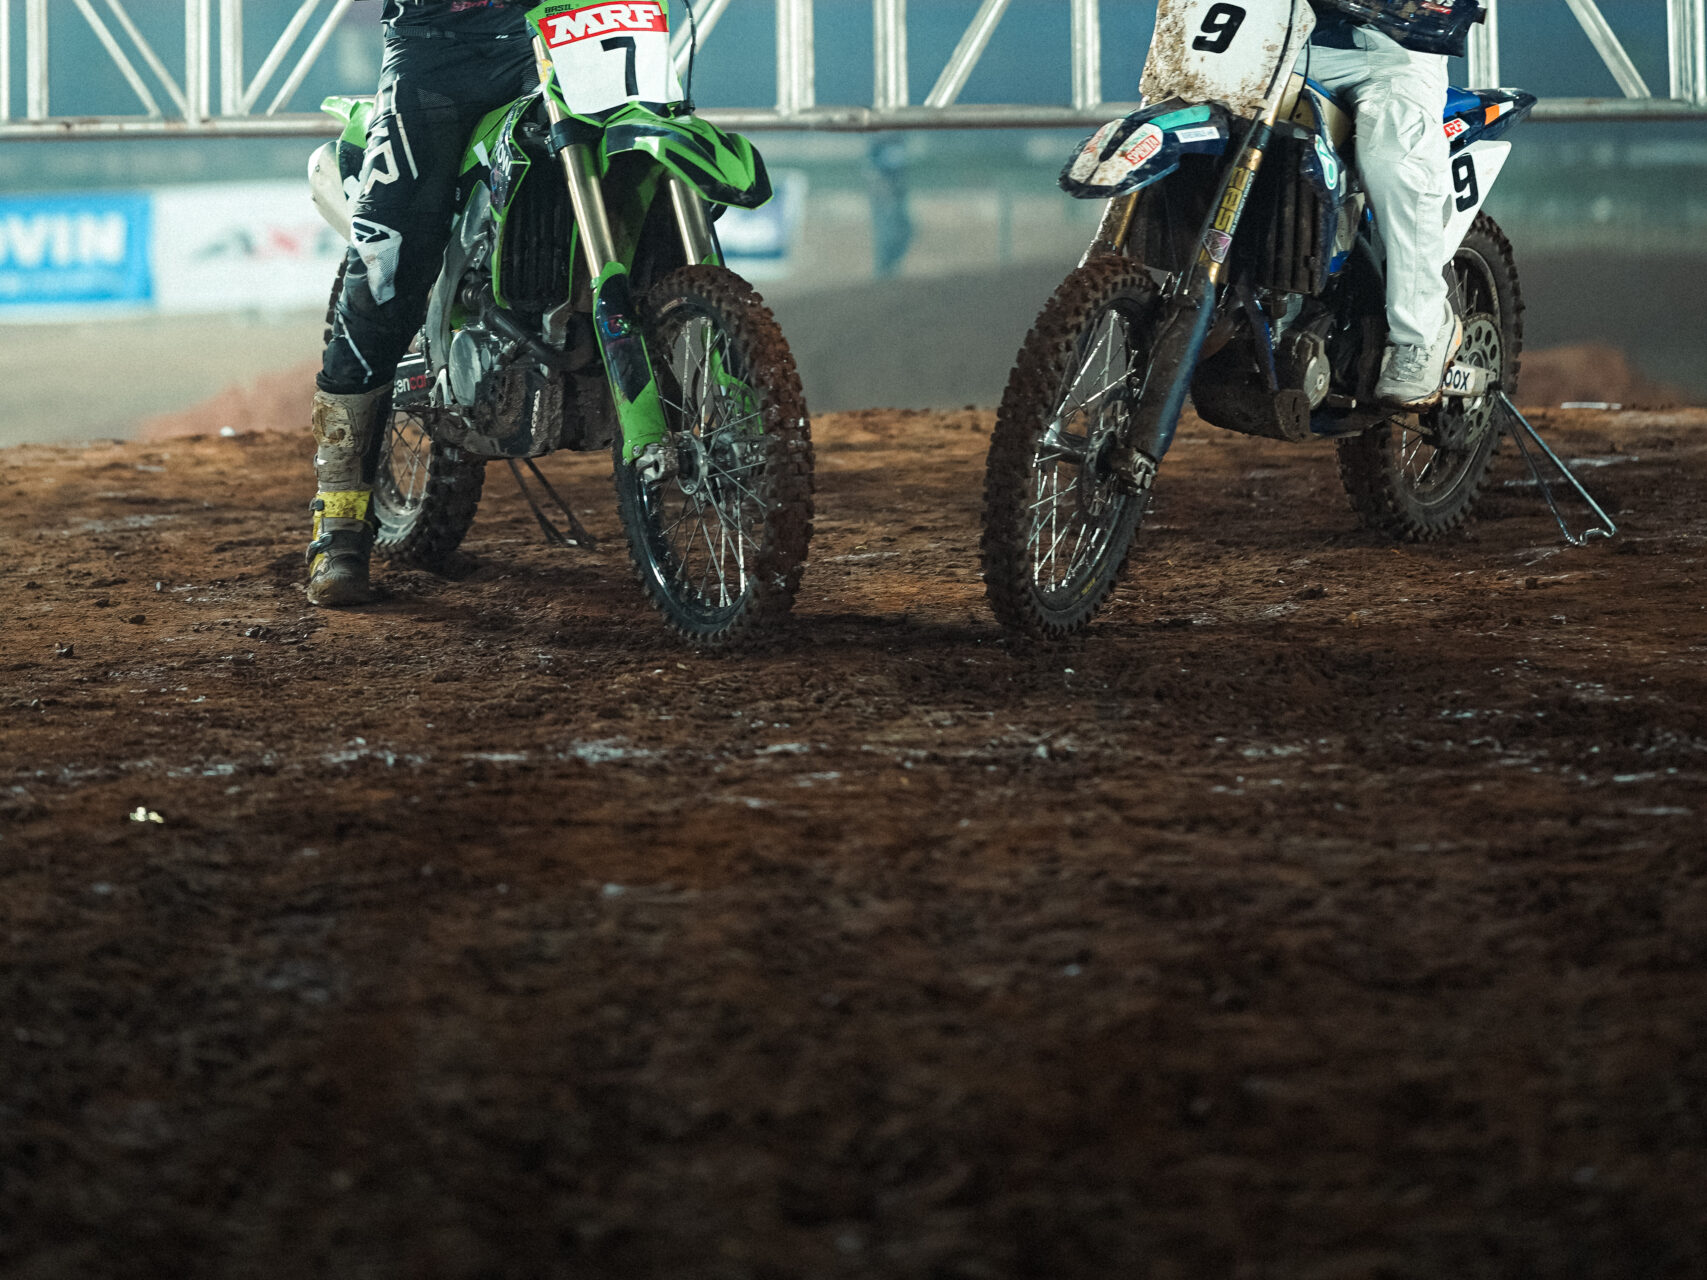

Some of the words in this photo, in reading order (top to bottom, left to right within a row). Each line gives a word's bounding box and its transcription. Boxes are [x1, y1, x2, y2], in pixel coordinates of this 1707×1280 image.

[546, 3, 662, 45] MRF
[1192, 2, 1246, 54] 9
[600, 36, 639, 97] 7
[1452, 152, 1479, 213] 9
